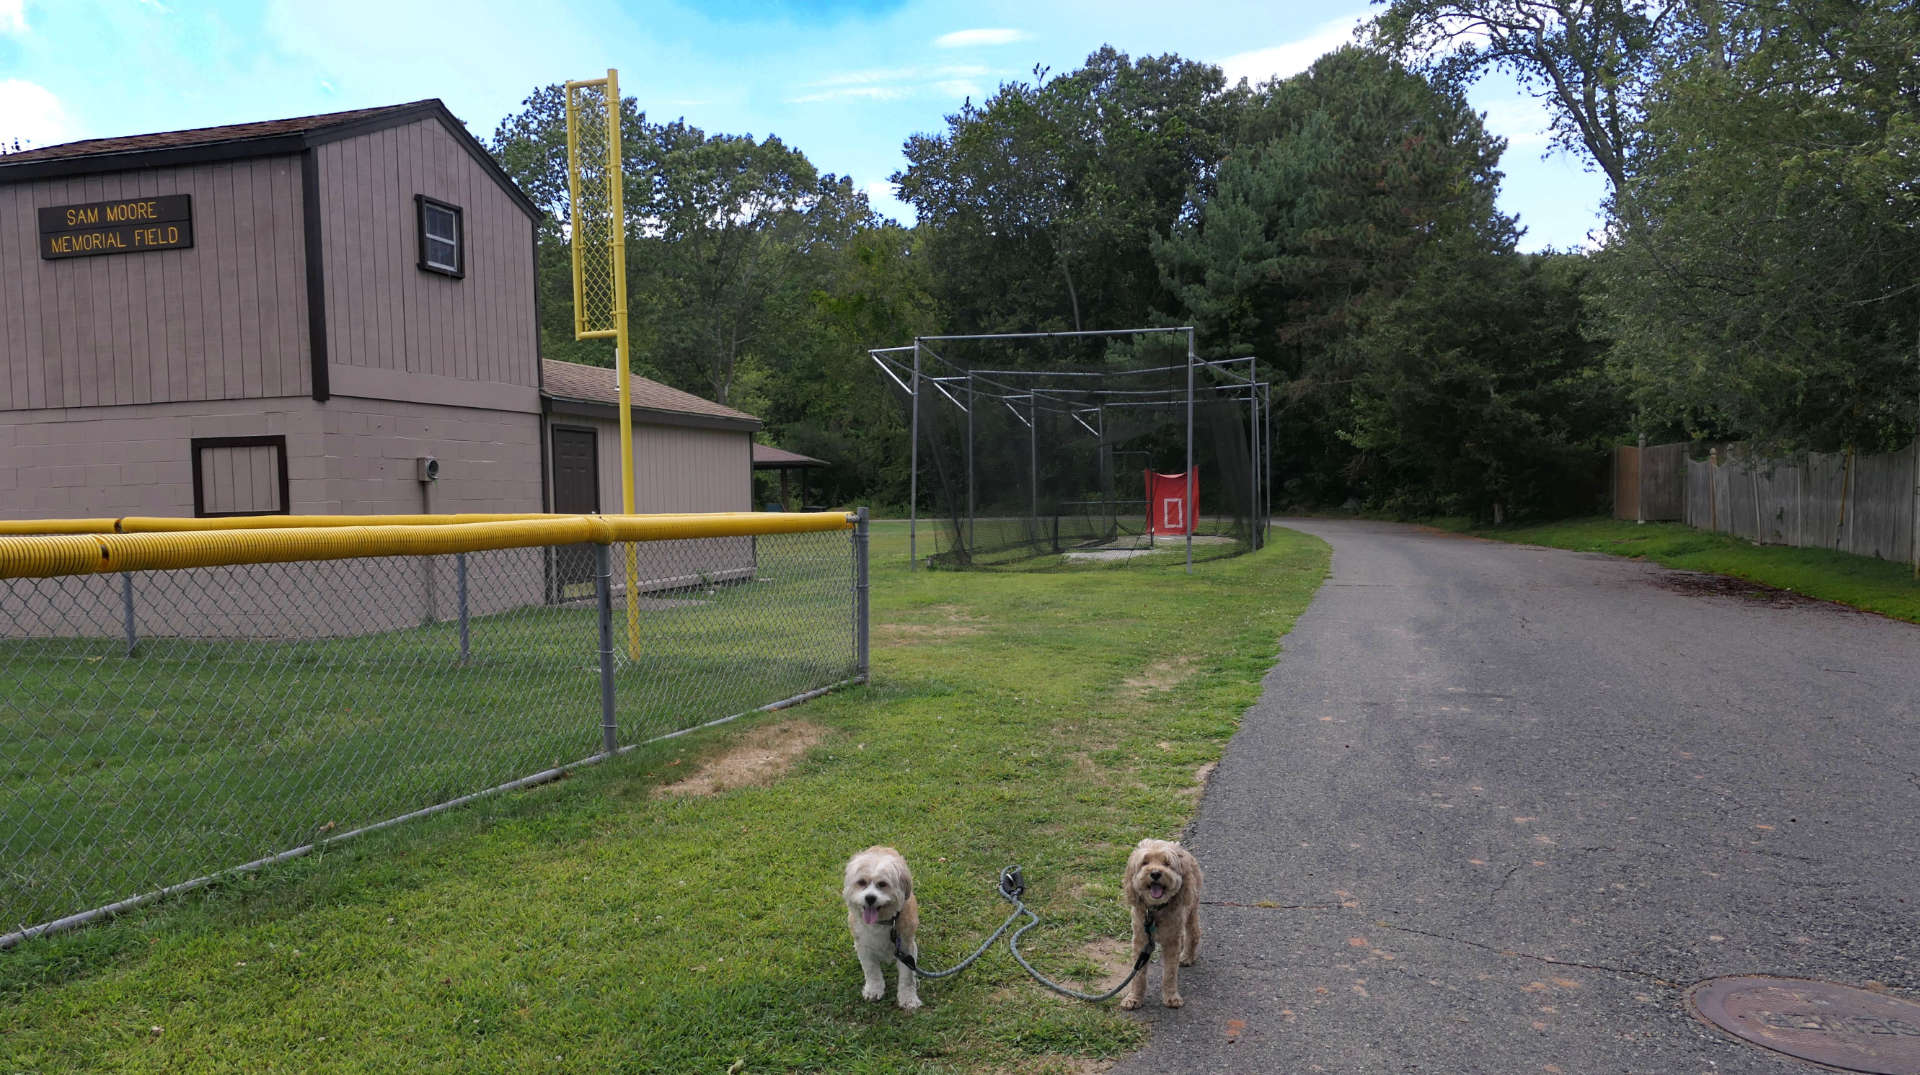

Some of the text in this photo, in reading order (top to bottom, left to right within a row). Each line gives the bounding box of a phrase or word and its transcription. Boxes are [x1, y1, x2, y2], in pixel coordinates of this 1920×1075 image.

[67, 202, 157, 226] SAM MOORE
[51, 227, 178, 253] MEMORIAL FIELD
